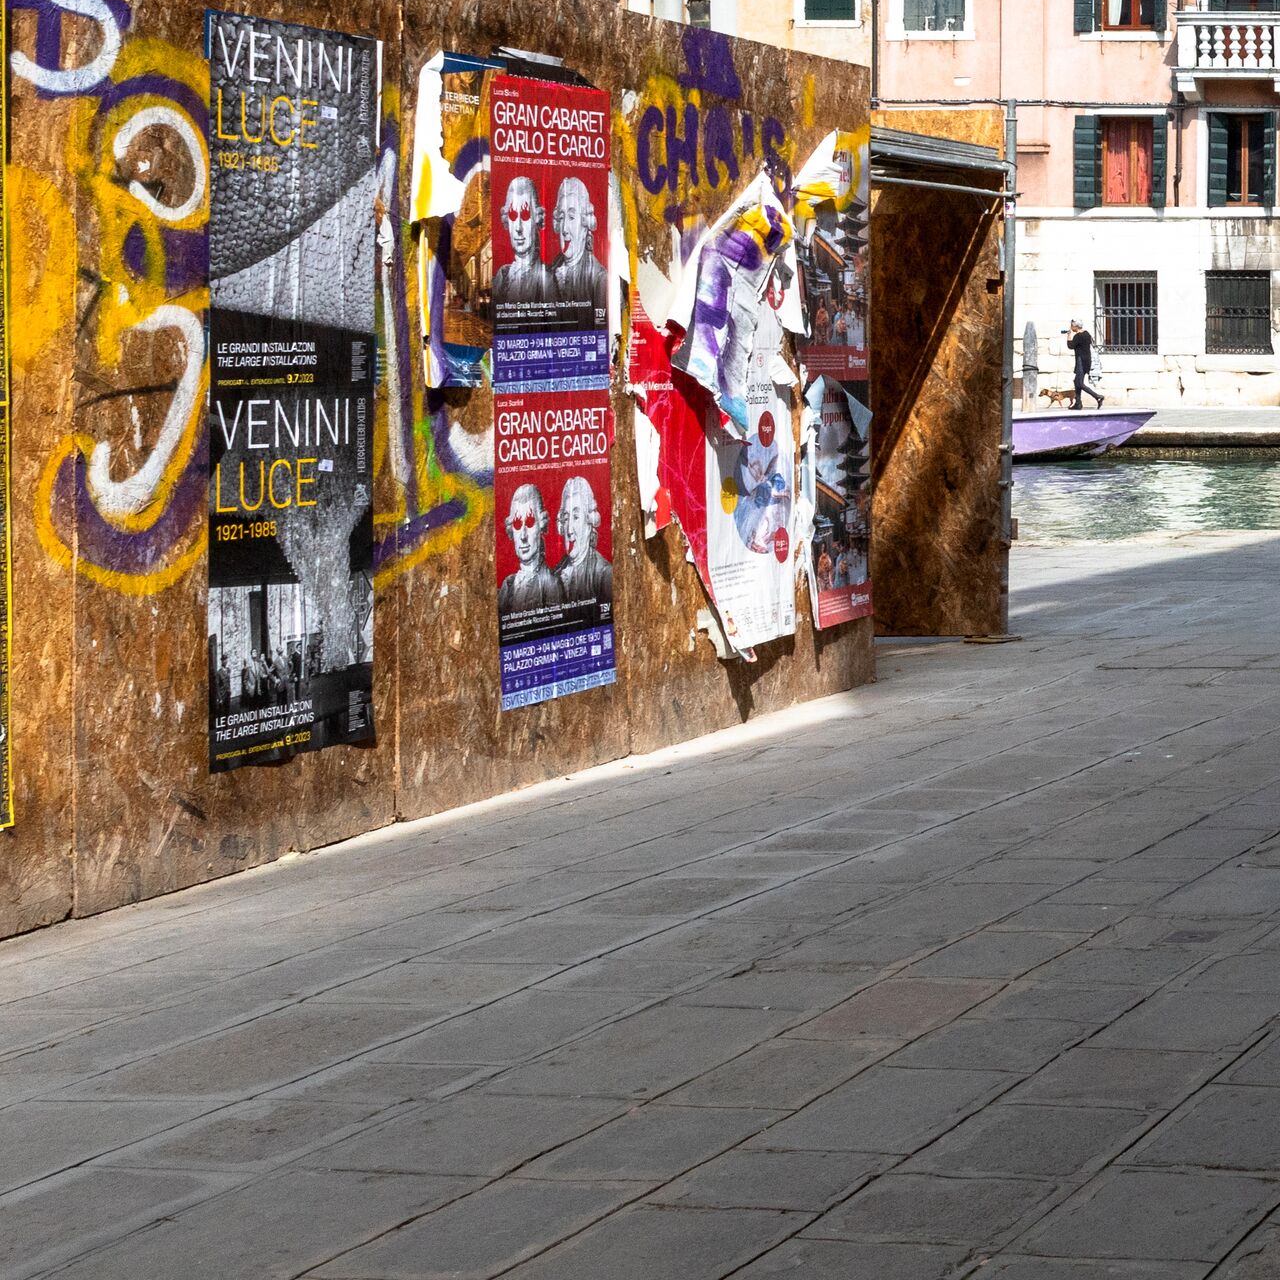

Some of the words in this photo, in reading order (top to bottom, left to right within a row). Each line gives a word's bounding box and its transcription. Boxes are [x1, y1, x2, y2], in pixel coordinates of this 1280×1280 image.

[217, 26, 353, 94] VENINI
[216, 88, 319, 149] LUCE
[494, 101, 538, 128] GRAN
[540, 105, 605, 134] CABARET
[494, 128, 544, 155] CARLO
[547, 133, 557, 155] E
[559, 134, 605, 159] CARLO
[217, 343, 228, 353] LE
[229, 342, 260, 353] GRANDI
[497, 340, 505, 350] 30
[507, 339, 529, 350] MARZO
[536, 338, 544, 348] 04
[569, 336, 580, 346] ORE
[217, 356, 234, 367] THE
[235, 356, 261, 367] LARGE
[497, 349, 526, 362] PALAZZO
[756, 382, 773, 394] Yoga
[216, 398, 349, 450] VENINI
[498, 411, 541, 435] GRAN
[544, 407, 607, 433] CABARET
[498, 436, 548, 462] CARLO
[551, 436, 560, 458] E
[562, 432, 607, 457] CARLO
[216, 457, 318, 513] LUCE
[216, 520, 278, 542] 1921-1985
[503, 651, 513, 661] 30
[513, 645, 536, 659] MARZO
[542, 642, 550, 652] 04
[551, 637, 575, 651] MAGGIO
[575, 634, 587, 646] ORE
[504, 659, 532, 673] PALAZZO
[216, 716, 226, 728] LE
[227, 710, 257, 726] GRANDI
[216, 729, 232, 742] THE
[233, 723, 260, 738] LARGE
